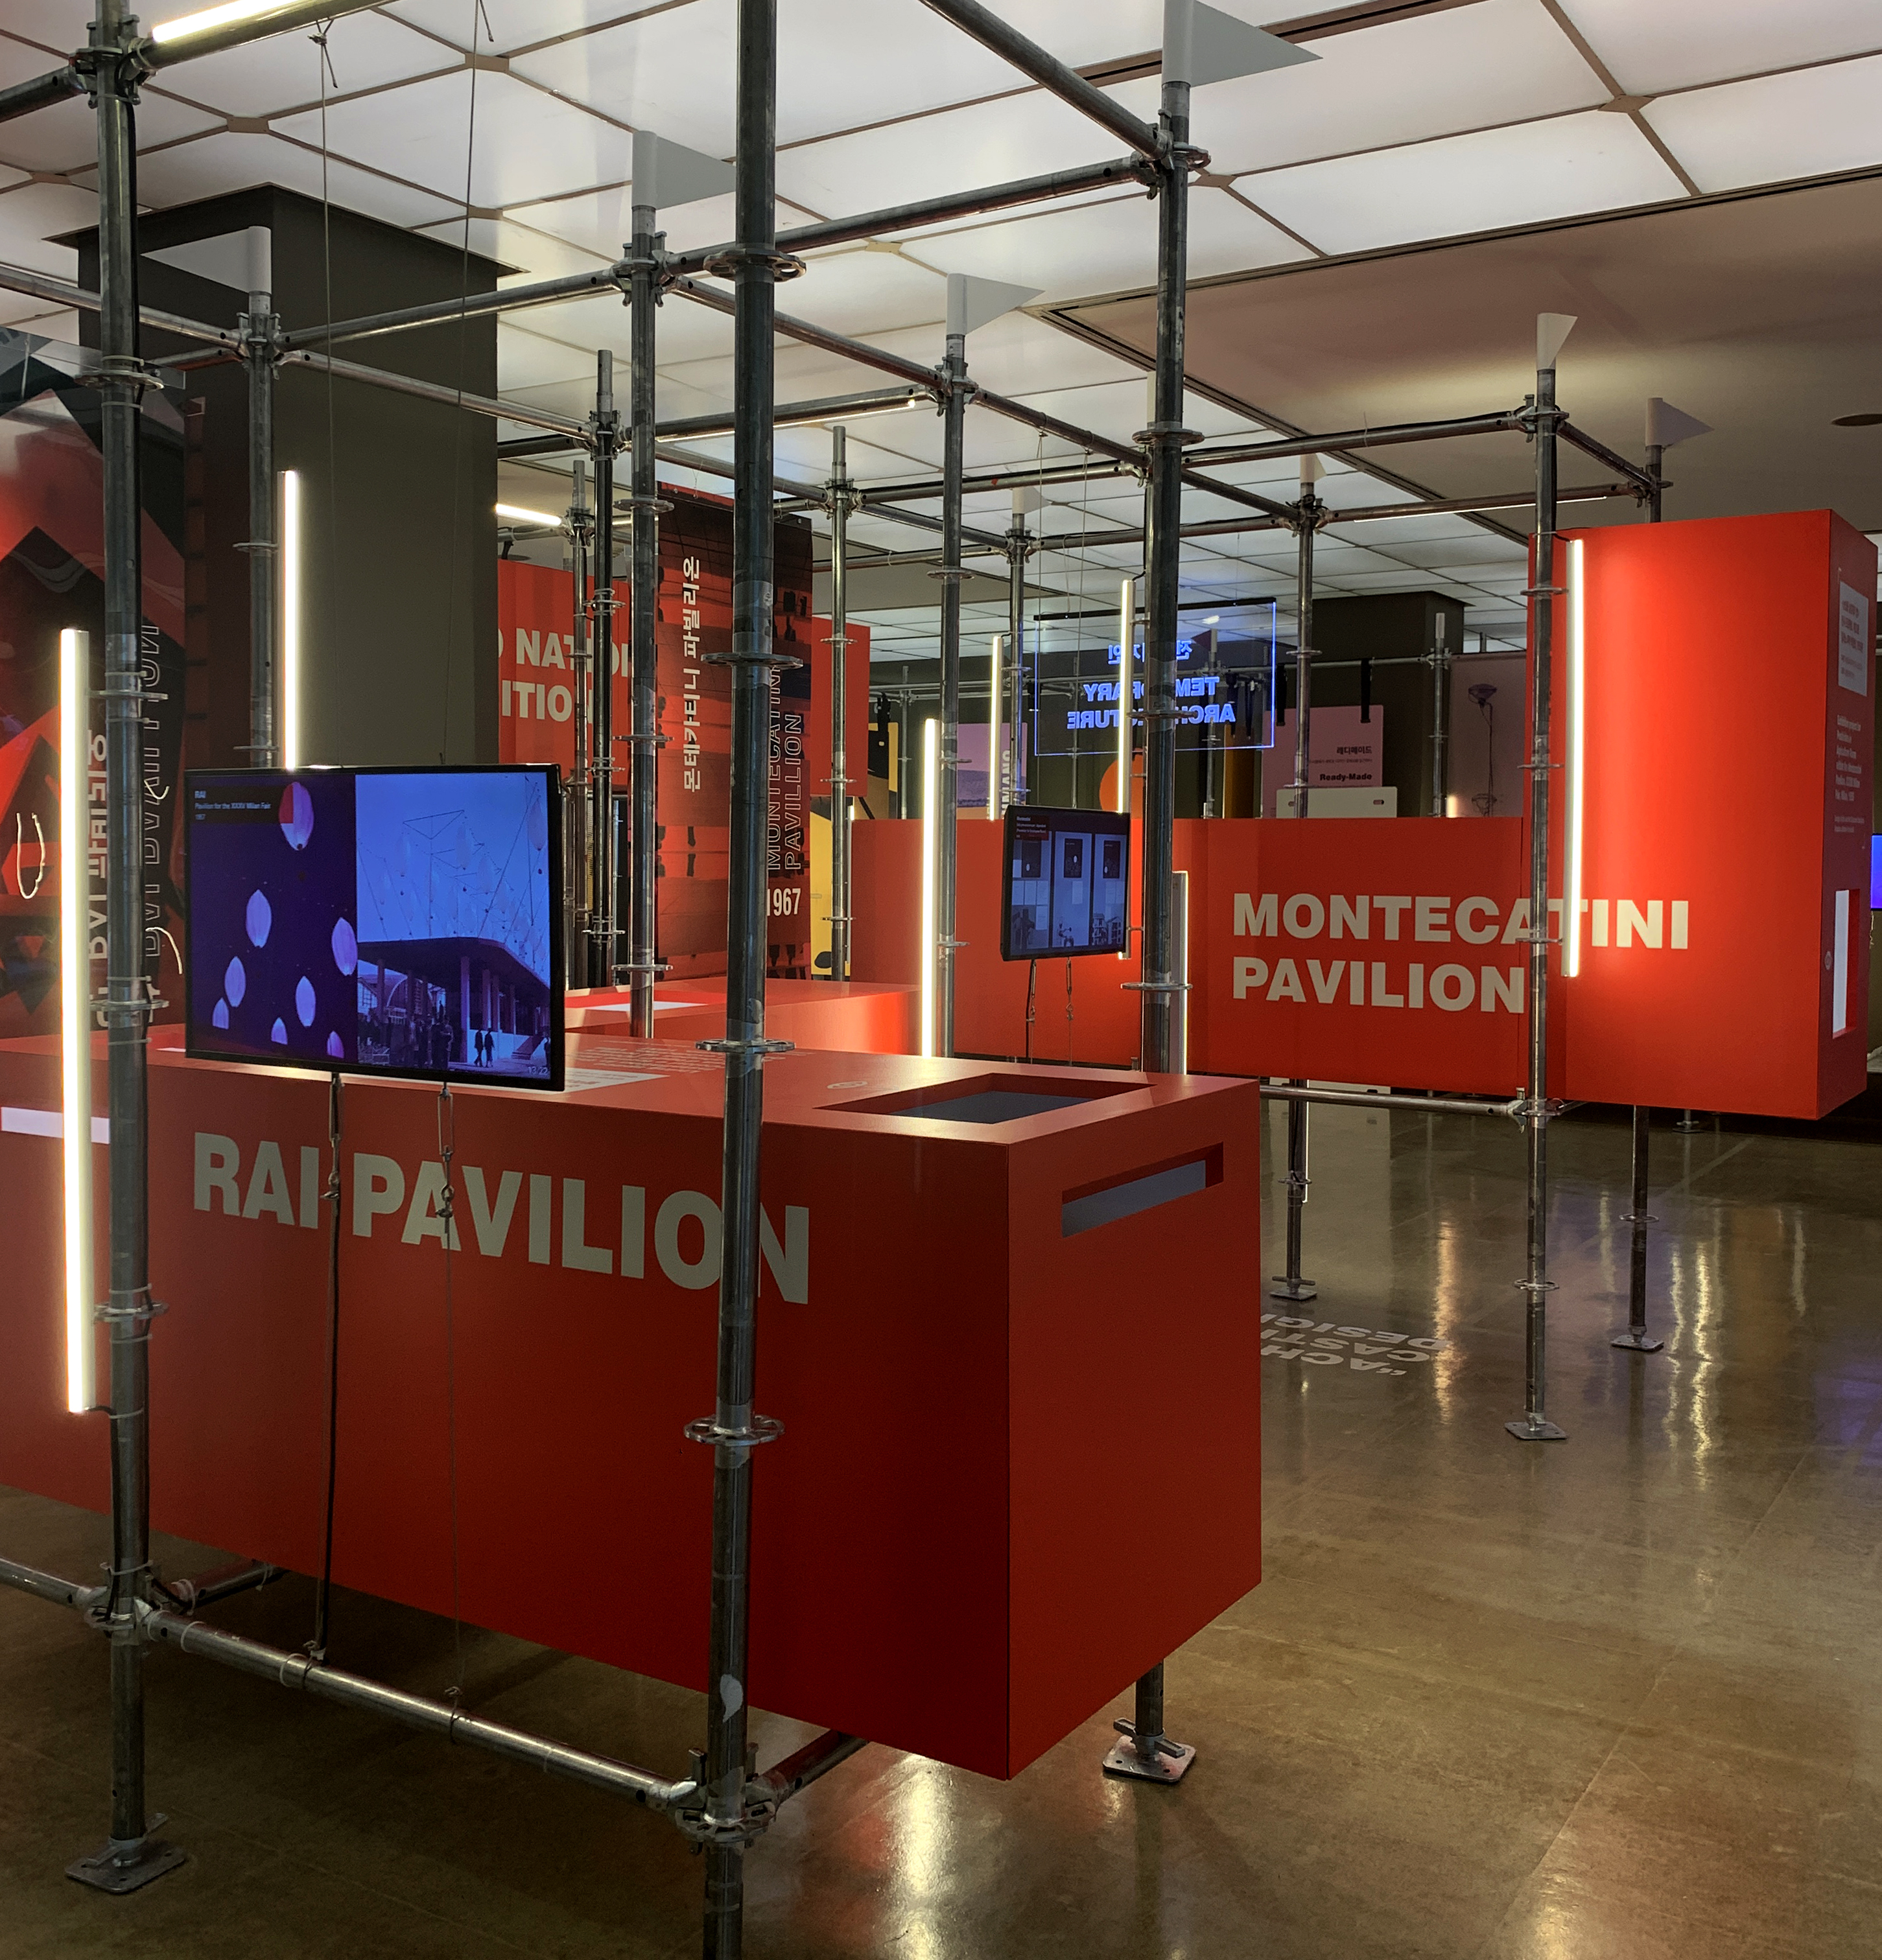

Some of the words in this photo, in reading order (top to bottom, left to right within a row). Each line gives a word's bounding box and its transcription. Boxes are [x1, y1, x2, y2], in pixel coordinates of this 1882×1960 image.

[683, 555, 700, 659] 파빌리온
[683, 668, 700, 793] 몬테카티니
[1336, 746, 1372, 754] 레디메이드
[784, 714, 802, 870] PAVILLION
[1320, 773, 1372, 782] Ready-Made
[767, 888, 801, 916] 1967
[1233, 957, 1524, 1014] PAVILION
[194, 1132, 319, 1230] RAI
[353, 1152, 809, 1305] PAVILION
